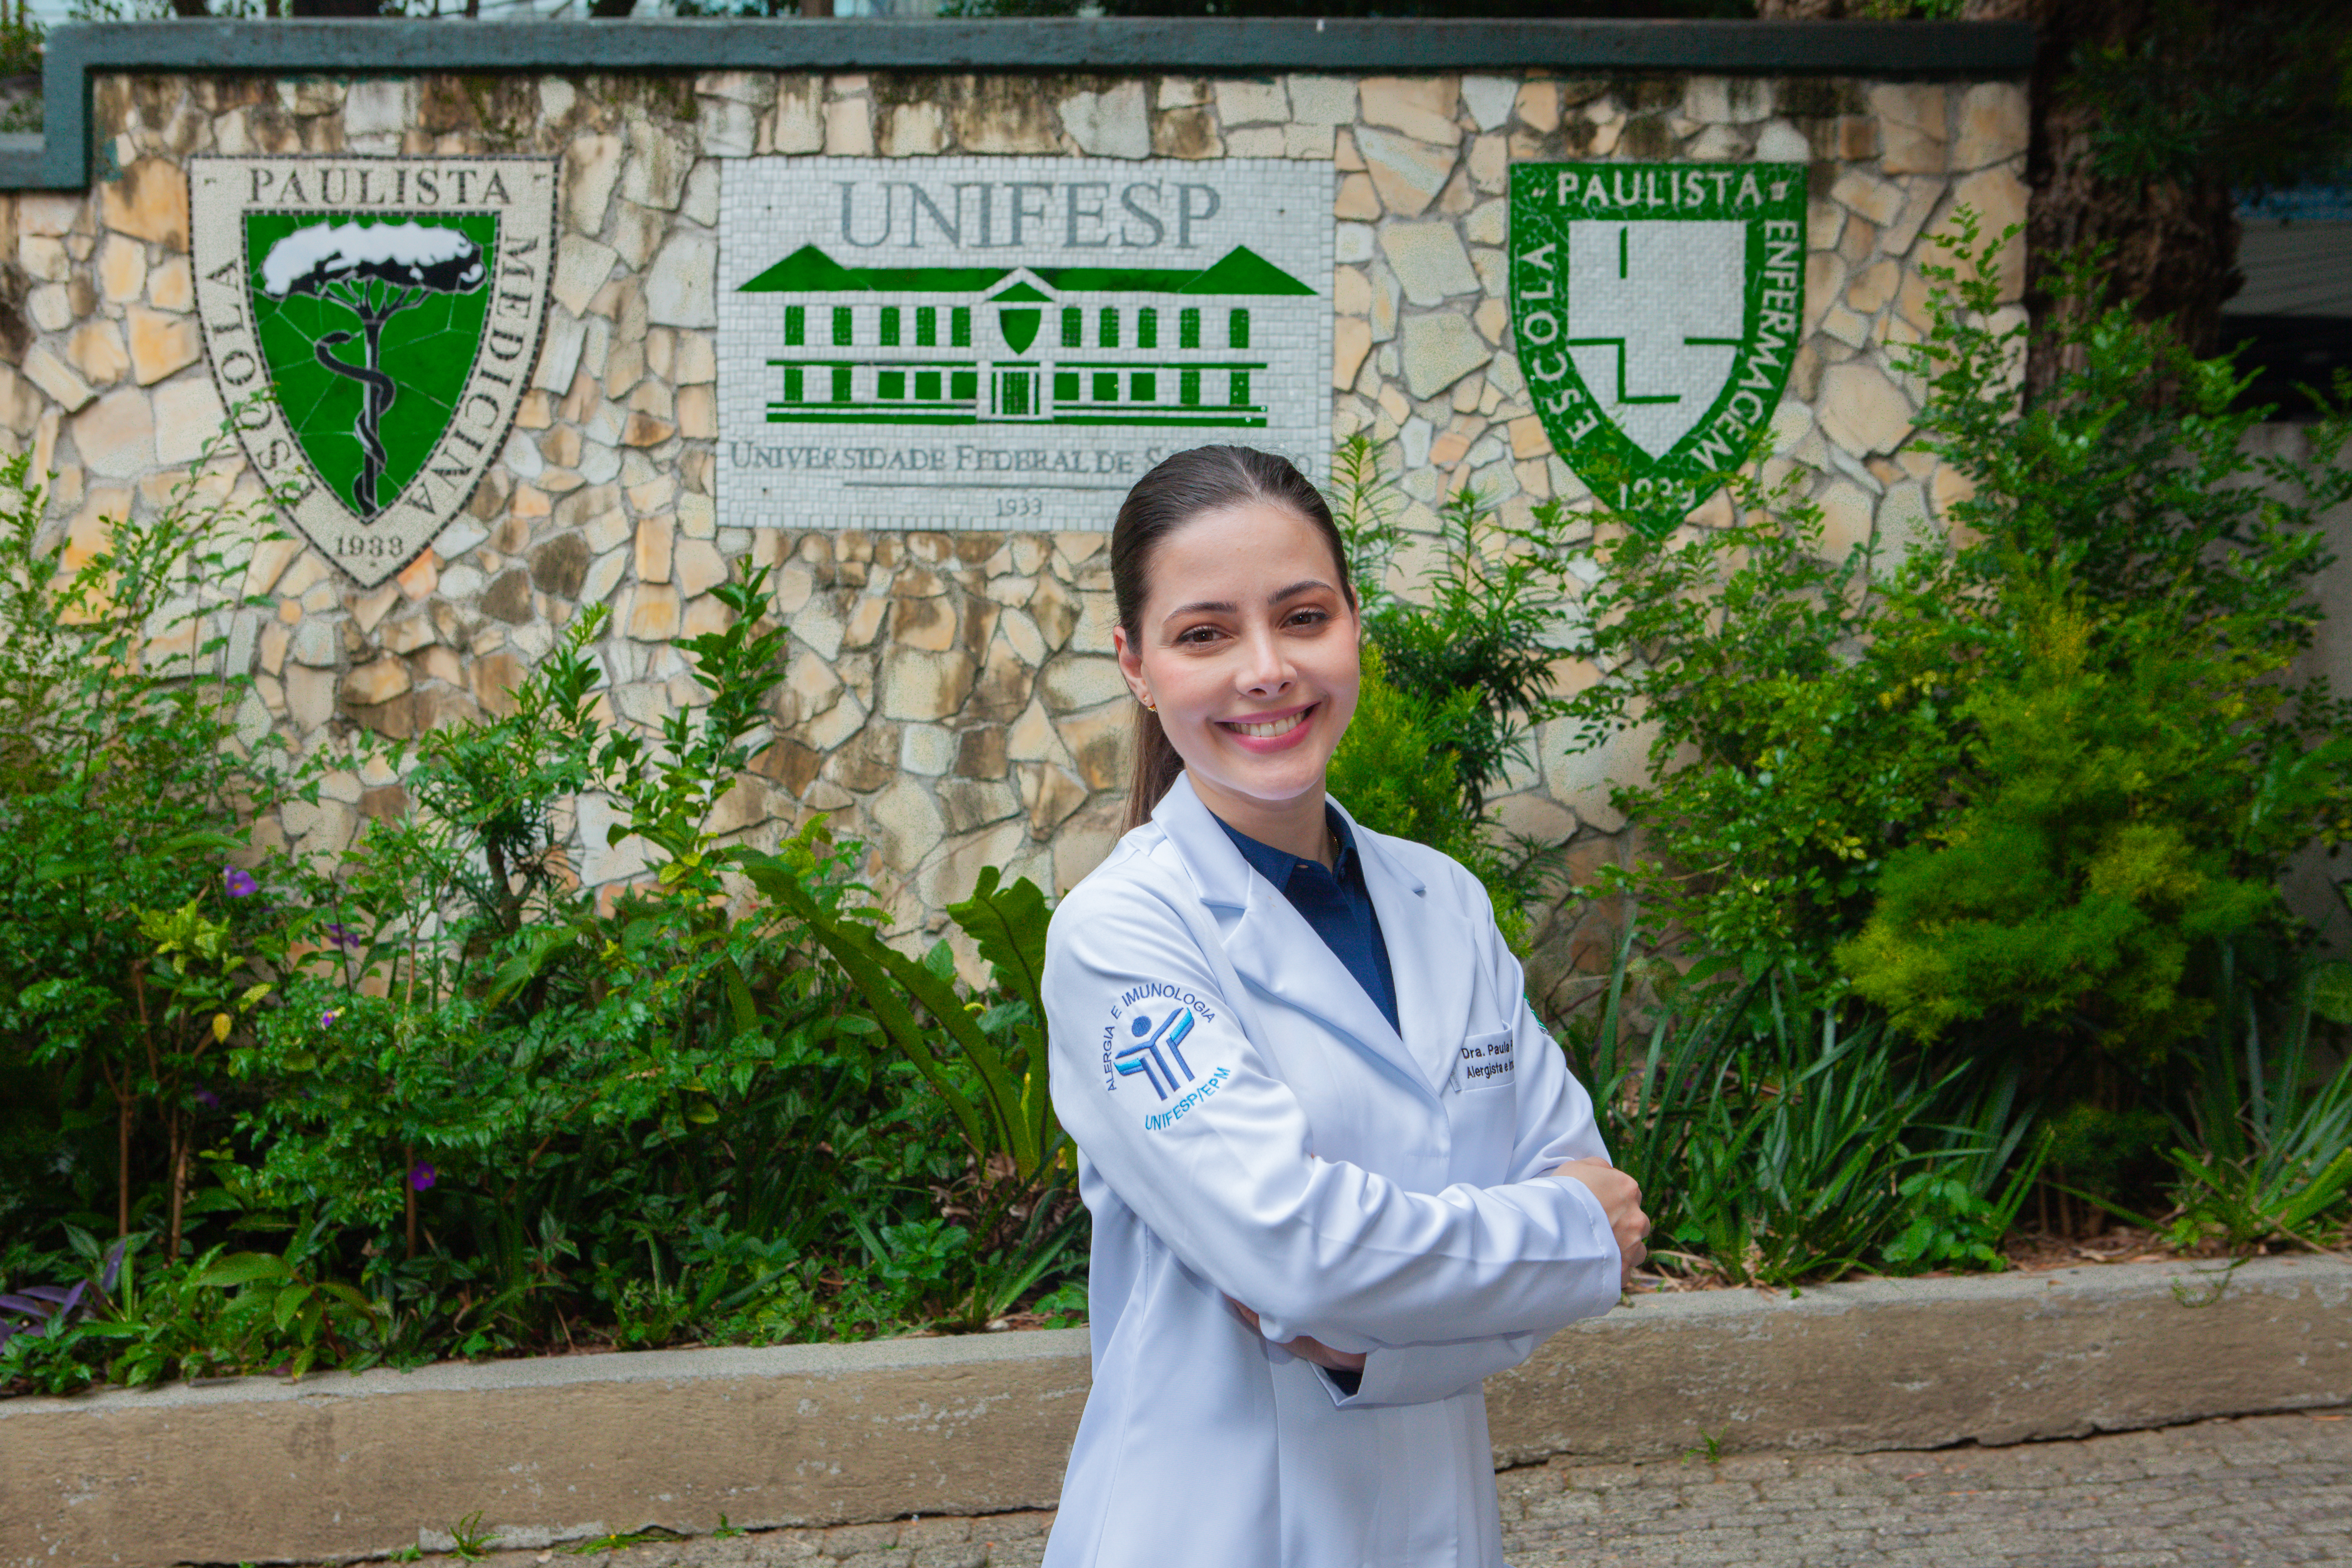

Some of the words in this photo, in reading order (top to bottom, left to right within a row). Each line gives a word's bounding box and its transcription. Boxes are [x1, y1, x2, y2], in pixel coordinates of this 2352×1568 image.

[246, 168, 512, 205] PAULISTA
[1557, 170, 1764, 208] PAULISTA
[837, 179, 1222, 250] UNIFESP
[1519, 242, 1600, 442] ESCOLA
[405, 235, 540, 515] MEDICINA
[1095, 450, 1134, 473] DE
[996, 497, 1043, 517] 1933
[1102, 1025, 1115, 1092] ALERGIA
[1111, 1005, 1122, 1019] E
[1121, 983, 1216, 1023] IMUNOLOGIA
[1461, 1048, 1485, 1059] Dra.
[1487, 1041, 1510, 1055] Paula
[1467, 1062, 1503, 1079] Alergista
[1504, 1062, 1509, 1072] e
[1145, 1066, 1231, 1131] UNIFESP/EPM
